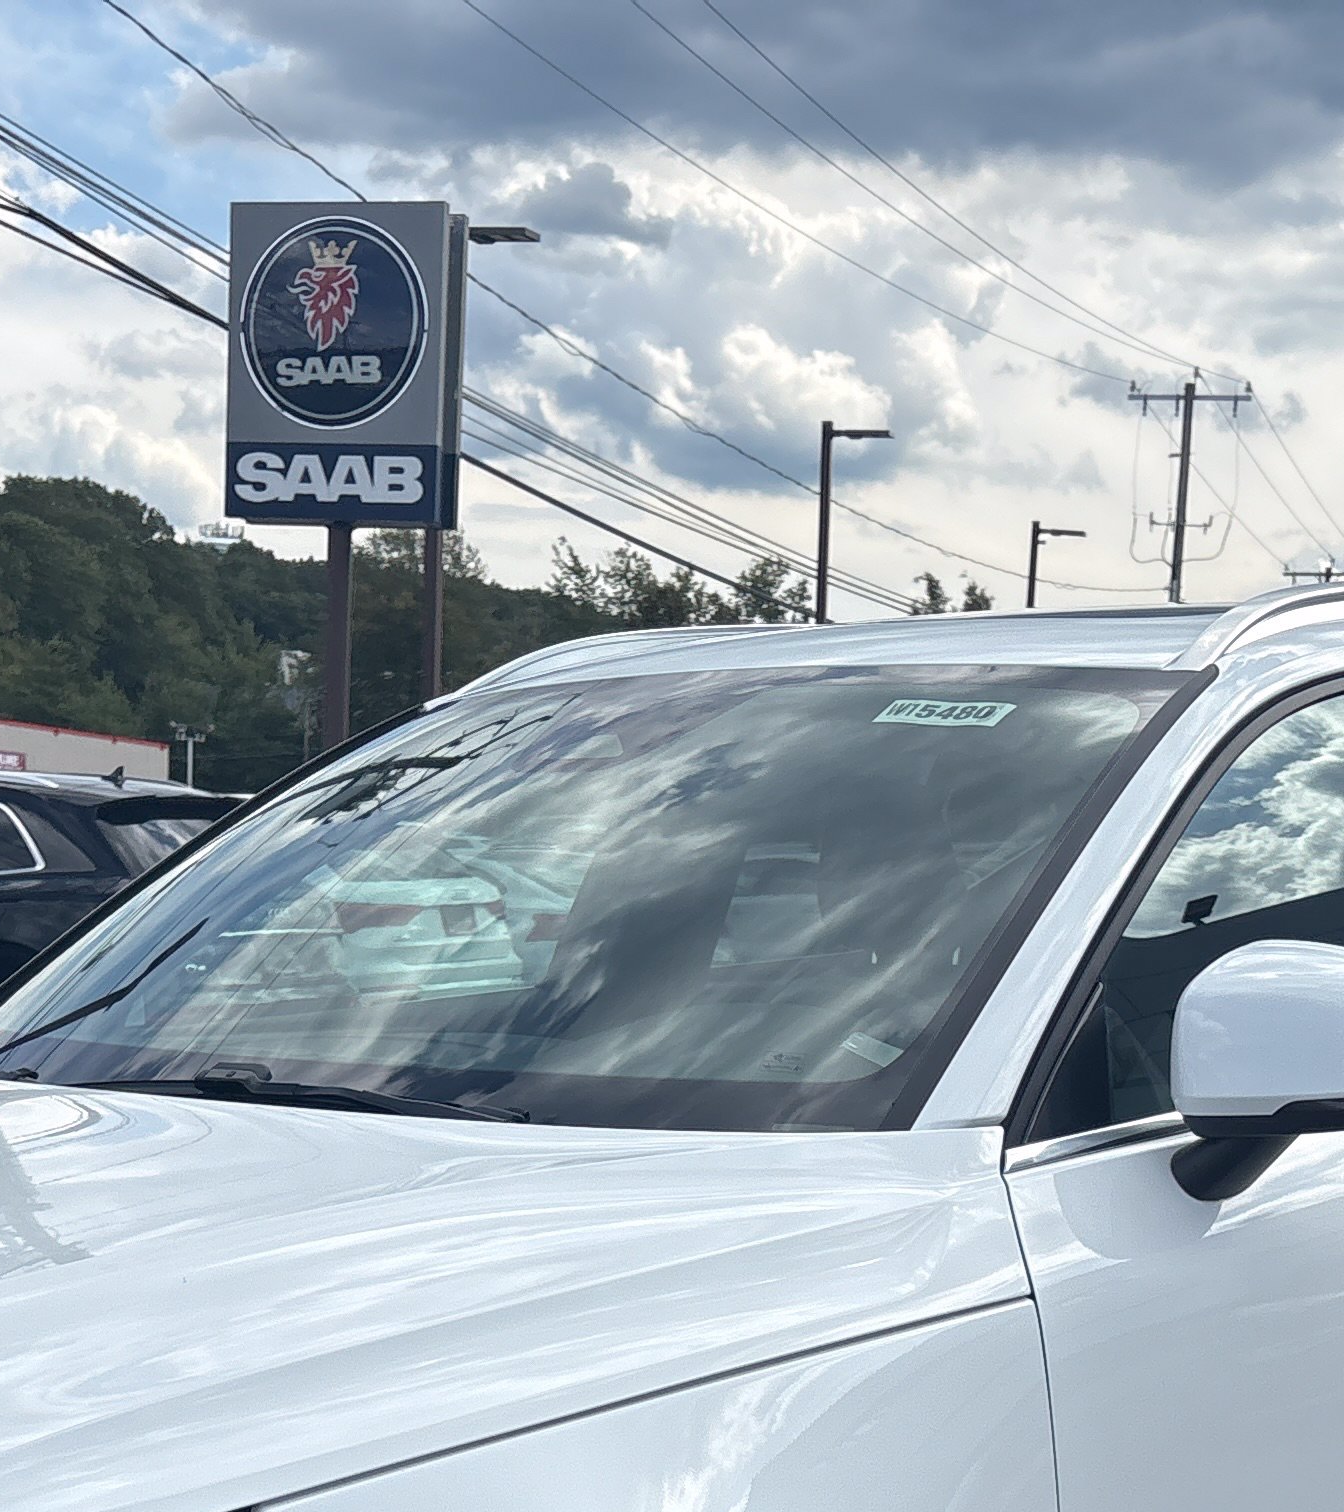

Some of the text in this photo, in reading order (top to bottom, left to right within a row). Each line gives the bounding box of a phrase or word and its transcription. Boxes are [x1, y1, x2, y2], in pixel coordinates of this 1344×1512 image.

[275, 354, 383, 387] SAAB
[233, 451, 425, 504] SAAB
[885, 702, 998, 721] W15480
